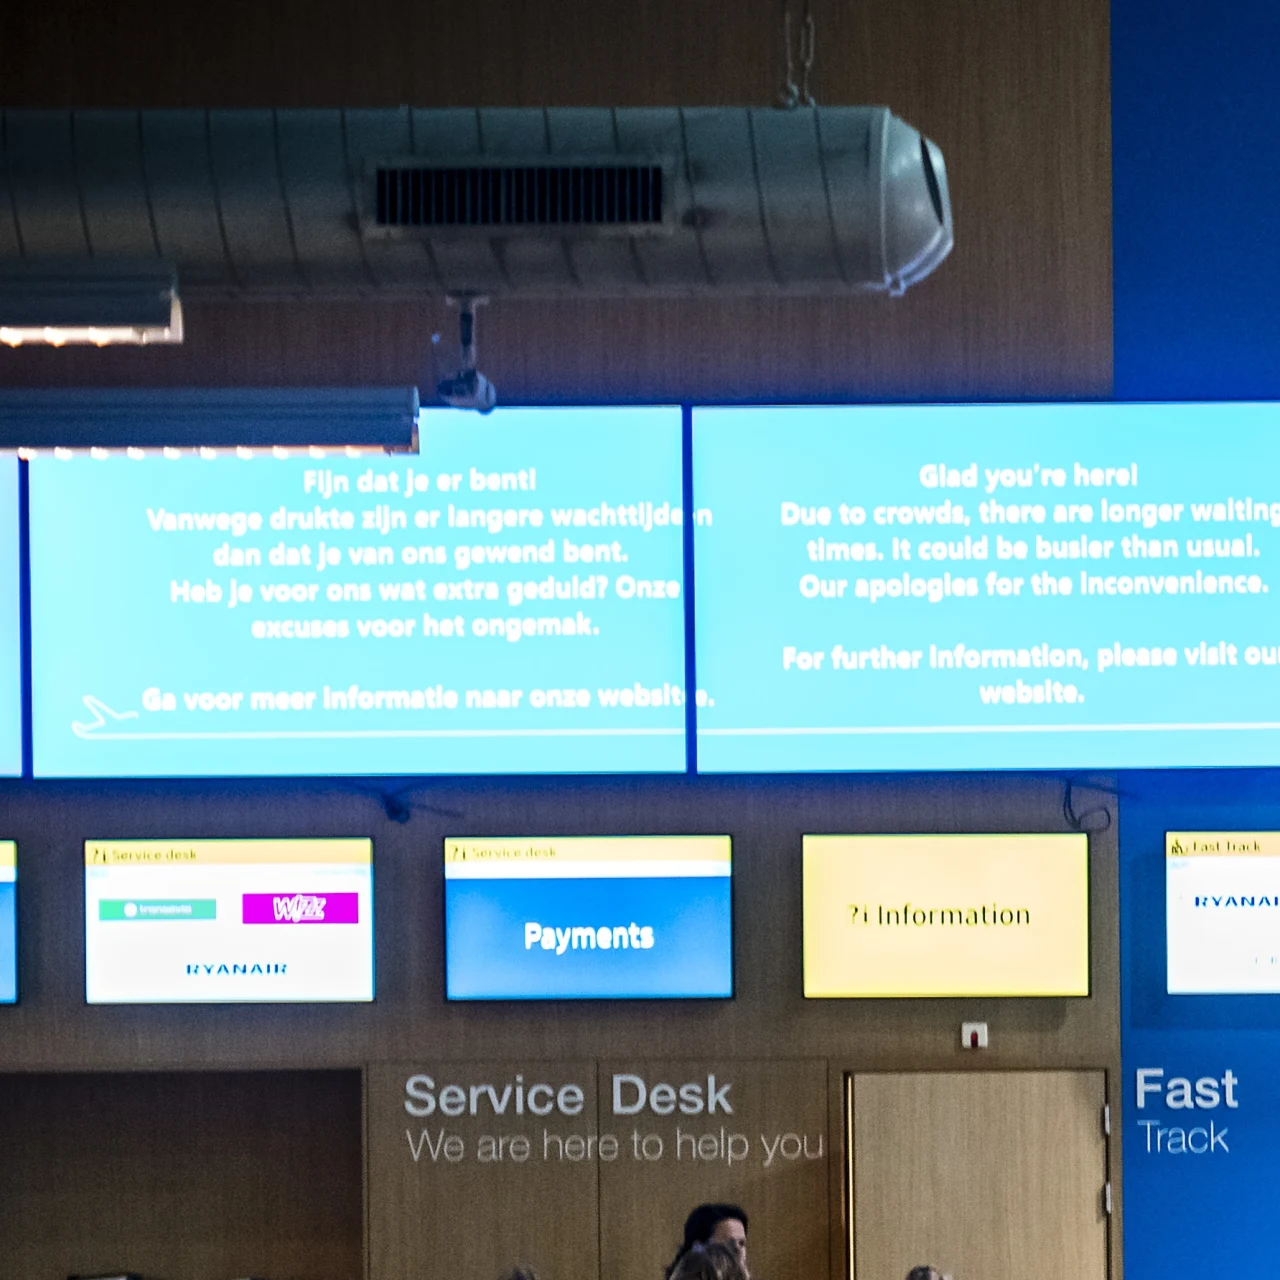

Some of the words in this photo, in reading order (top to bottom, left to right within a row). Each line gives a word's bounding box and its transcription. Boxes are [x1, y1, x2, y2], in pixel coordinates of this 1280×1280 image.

[303, 469, 350, 499] Fijn
[356, 468, 399, 493] dat
[404, 468, 430, 499] je
[436, 473, 463, 492] er
[919, 462, 978, 488] Glad
[984, 463, 1067, 494] you're
[145, 507, 263, 537] Vanwege
[269, 505, 355, 531] drukte
[361, 504, 407, 535] zijn
[414, 510, 441, 529] er
[447, 503, 544, 534] langere
[781, 501, 832, 526] Due
[838, 503, 867, 526] to
[873, 499, 971, 527] crowds,
[978, 498, 1047, 524] there
[1053, 504, 1094, 523] are
[1101, 498, 1185, 528] longer
[212, 542, 262, 567] dan
[268, 541, 312, 567] dat
[316, 541, 342, 572] je
[348, 546, 394, 566] van
[401, 545, 447, 565] ons
[453, 538, 555, 571] gewend
[563, 538, 629, 563] bent.
[806, 537, 884, 562] times.
[892, 537, 911, 561] It
[917, 535, 989, 561] could
[996, 535, 1029, 560] be
[1035, 534, 1115, 559] busier
[1120, 534, 1179, 559] than
[1186, 533, 1260, 558] usual.
[169, 578, 223, 604] Heb
[227, 578, 253, 609] je
[259, 583, 320, 603] voor
[326, 583, 372, 602] ons
[378, 579, 427, 601] wat
[432, 579, 499, 601] extra
[506, 574, 609, 607] geduld?
[615, 574, 681, 599] Onze
[799, 574, 848, 599] Our
[854, 572, 979, 604] apologies
[985, 571, 1025, 596] for
[1030, 570, 1073, 596] the
[1080, 569, 1269, 595] inconvenience.
[250, 619, 350, 639] excuses
[356, 618, 417, 638] voor
[423, 612, 465, 637] het
[471, 611, 600, 643] ongemak.
[782, 646, 825, 671] For
[830, 644, 923, 670] further
[929, 642, 1089, 671] information,
[1097, 641, 1178, 673] please
[1183, 641, 1238, 666] visit
[141, 686, 177, 712] Ga
[183, 691, 244, 712] voor
[249, 691, 317, 711] meer
[323, 684, 459, 710] informatie
[465, 689, 524, 709] naar
[528, 688, 592, 709] onze
[979, 678, 1085, 705] website.
[878, 902, 1031, 927] Information
[524, 922, 655, 956] Payments
[186, 963, 288, 976] RYANAIR
[404, 1073, 585, 1117] Service
[612, 1073, 734, 1115] Desk
[1136, 1067, 1239, 1110] Fast
[406, 1127, 465, 1163] We
[477, 1134, 531, 1163] are
[543, 1127, 619, 1162] here
[631, 1126, 663, 1161] to
[676, 1125, 749, 1167] help
[760, 1132, 823, 1168] you
[1136, 1119, 1230, 1154] Track
